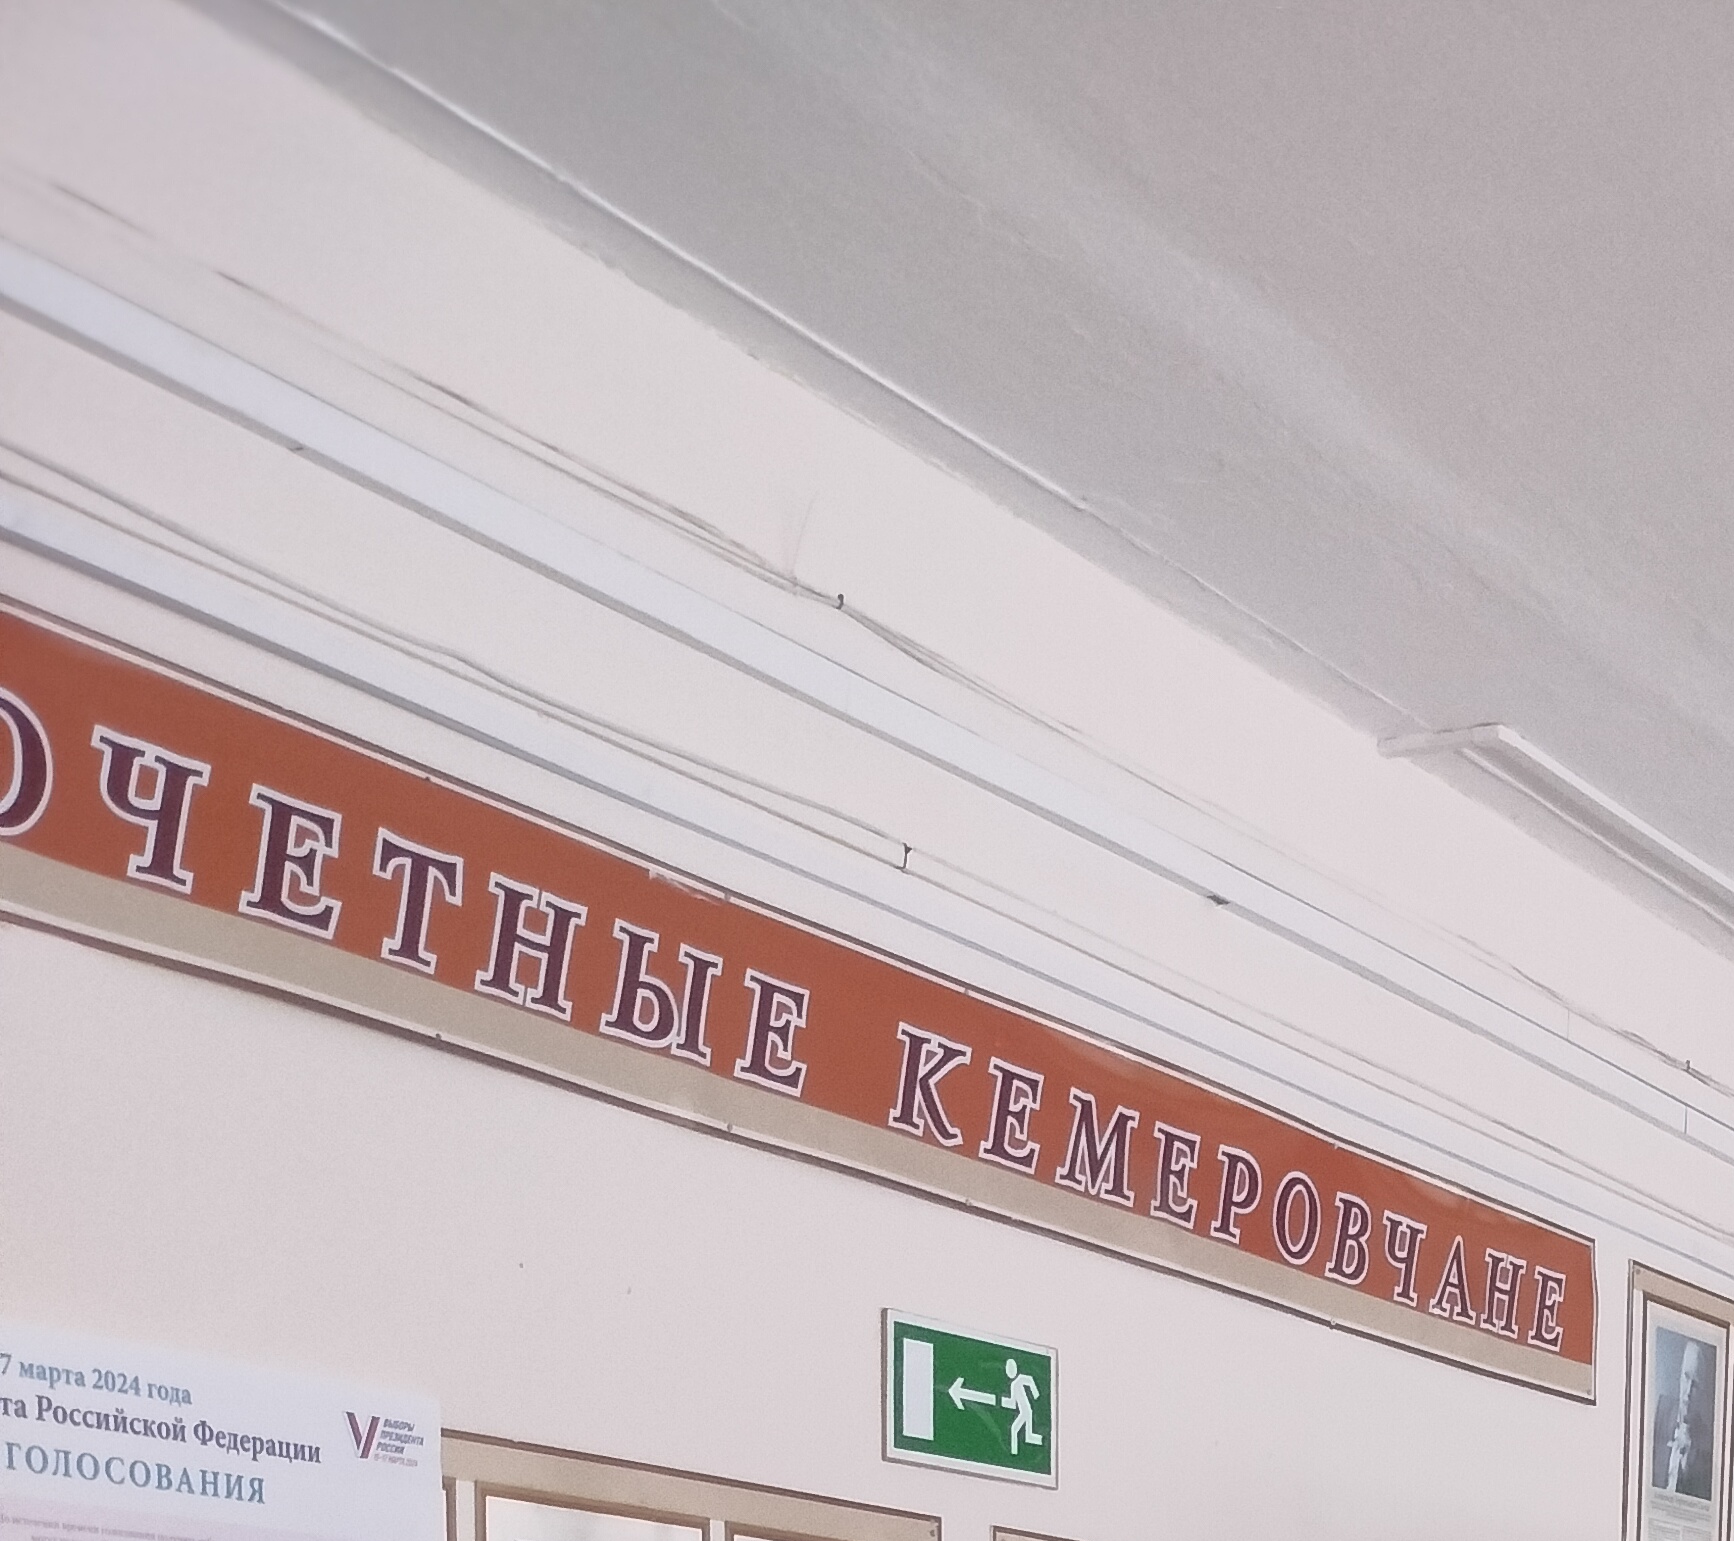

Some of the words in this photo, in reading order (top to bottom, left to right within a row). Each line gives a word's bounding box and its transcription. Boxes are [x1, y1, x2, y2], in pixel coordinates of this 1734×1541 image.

[887, 1021, 1568, 1352] КЕМЕРОВЧАНЕ
[19, 1360, 87, 1390] марта
[91, 1368, 141, 1397] 2024
[146, 1382, 193, 1407] года
[0, 1396, 28, 1420] та
[35, 1394, 187, 1444] Российской
[193, 1419, 322, 1464] Федерации
[5, 1440, 266, 1505] ГОЛОСОВАНИЯ
